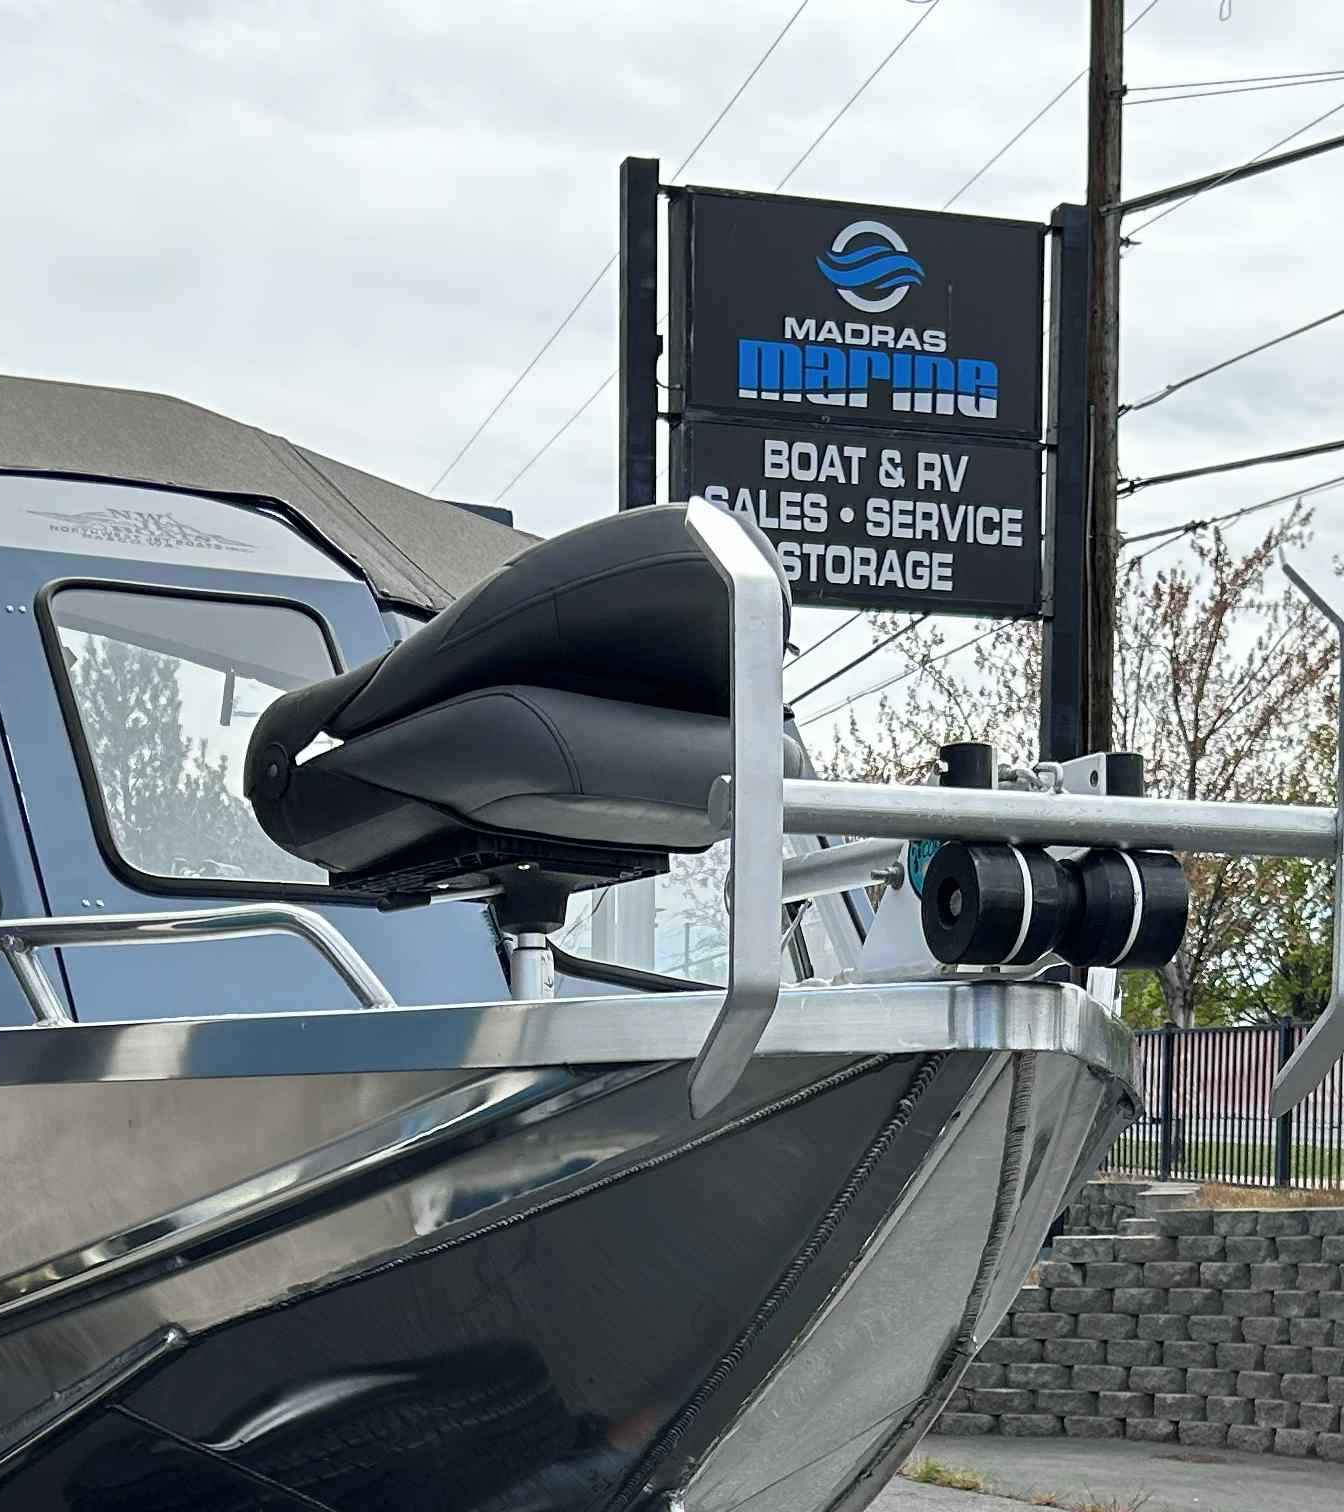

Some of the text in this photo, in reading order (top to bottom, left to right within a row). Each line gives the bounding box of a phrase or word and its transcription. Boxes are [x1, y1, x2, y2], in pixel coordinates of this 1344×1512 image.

[784, 316, 947, 353] MADRAS
[737, 338, 999, 419] marine
[763, 439, 970, 493] BOAT & RV
[866, 498, 1023, 547] SERVICE
[776, 541, 954, 592] STORAGE
